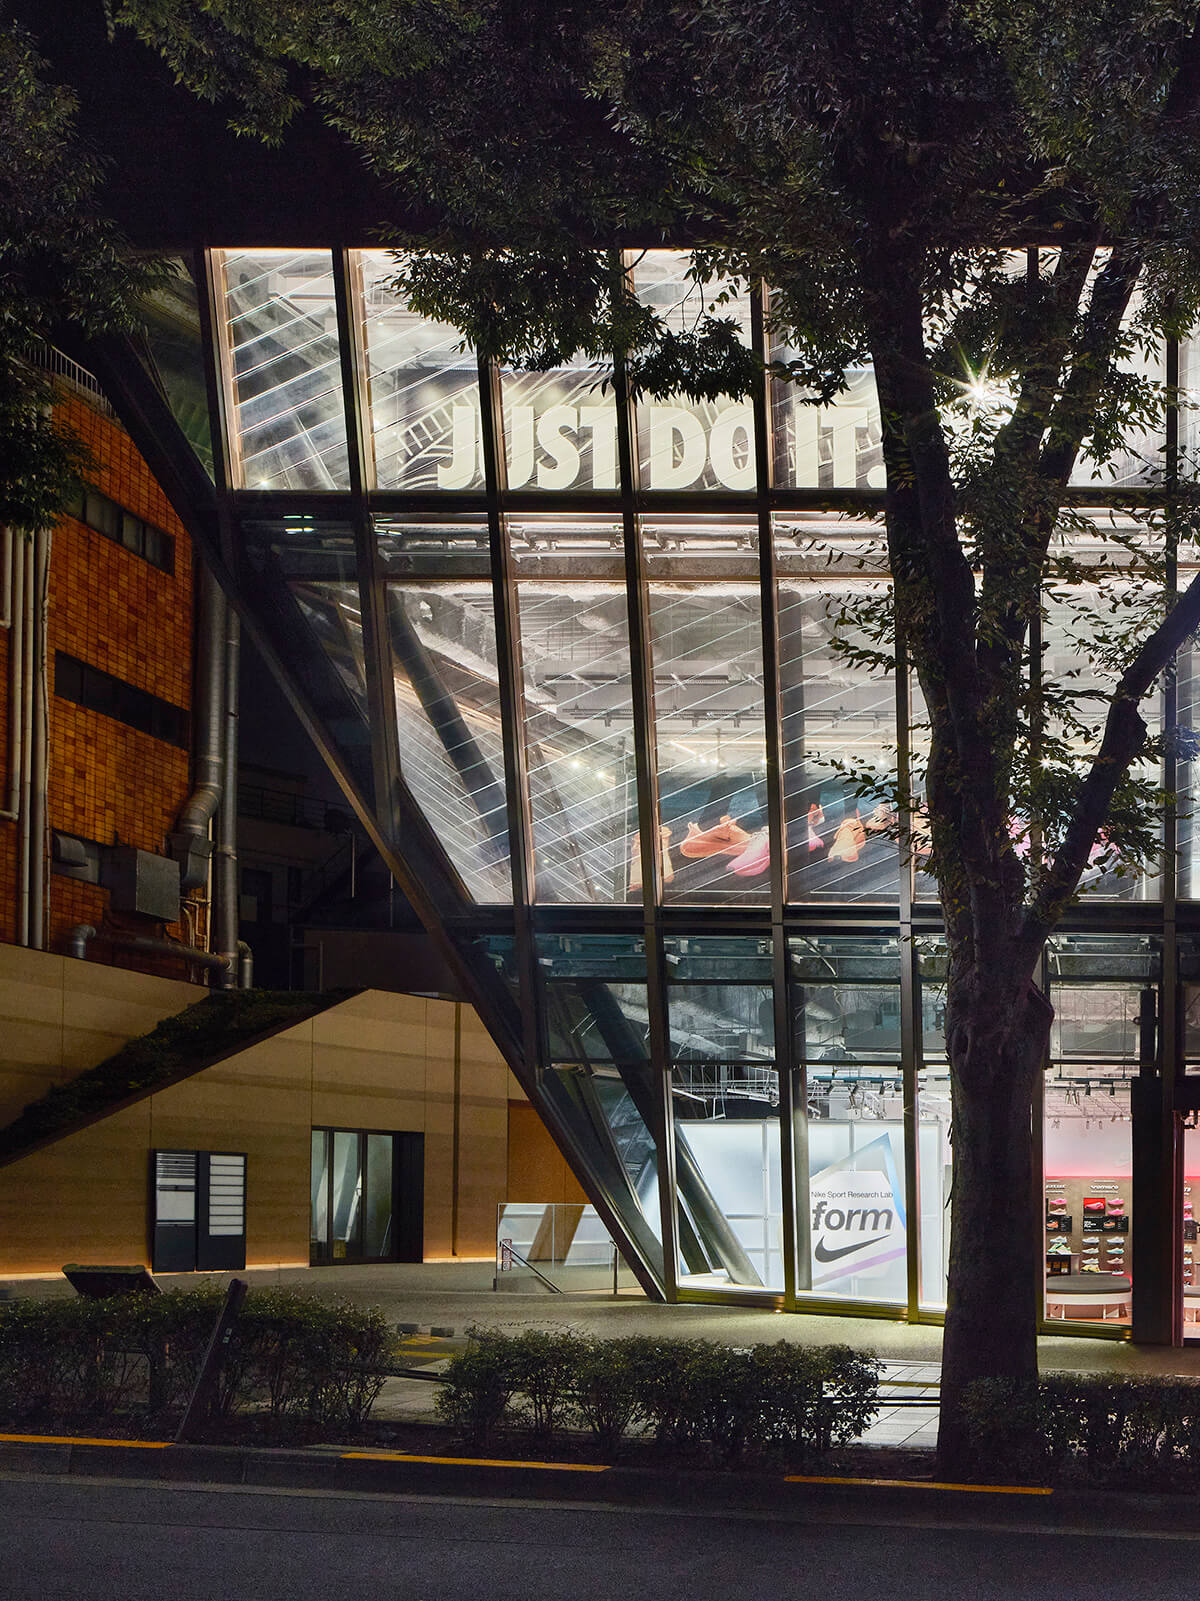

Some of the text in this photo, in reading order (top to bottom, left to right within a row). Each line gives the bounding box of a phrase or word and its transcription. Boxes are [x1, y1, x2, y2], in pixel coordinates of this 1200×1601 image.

[437, 406, 888, 492] JUST DO IT.
[827, 1191, 846, 1199] Sport
[812, 1200, 893, 1231] form
